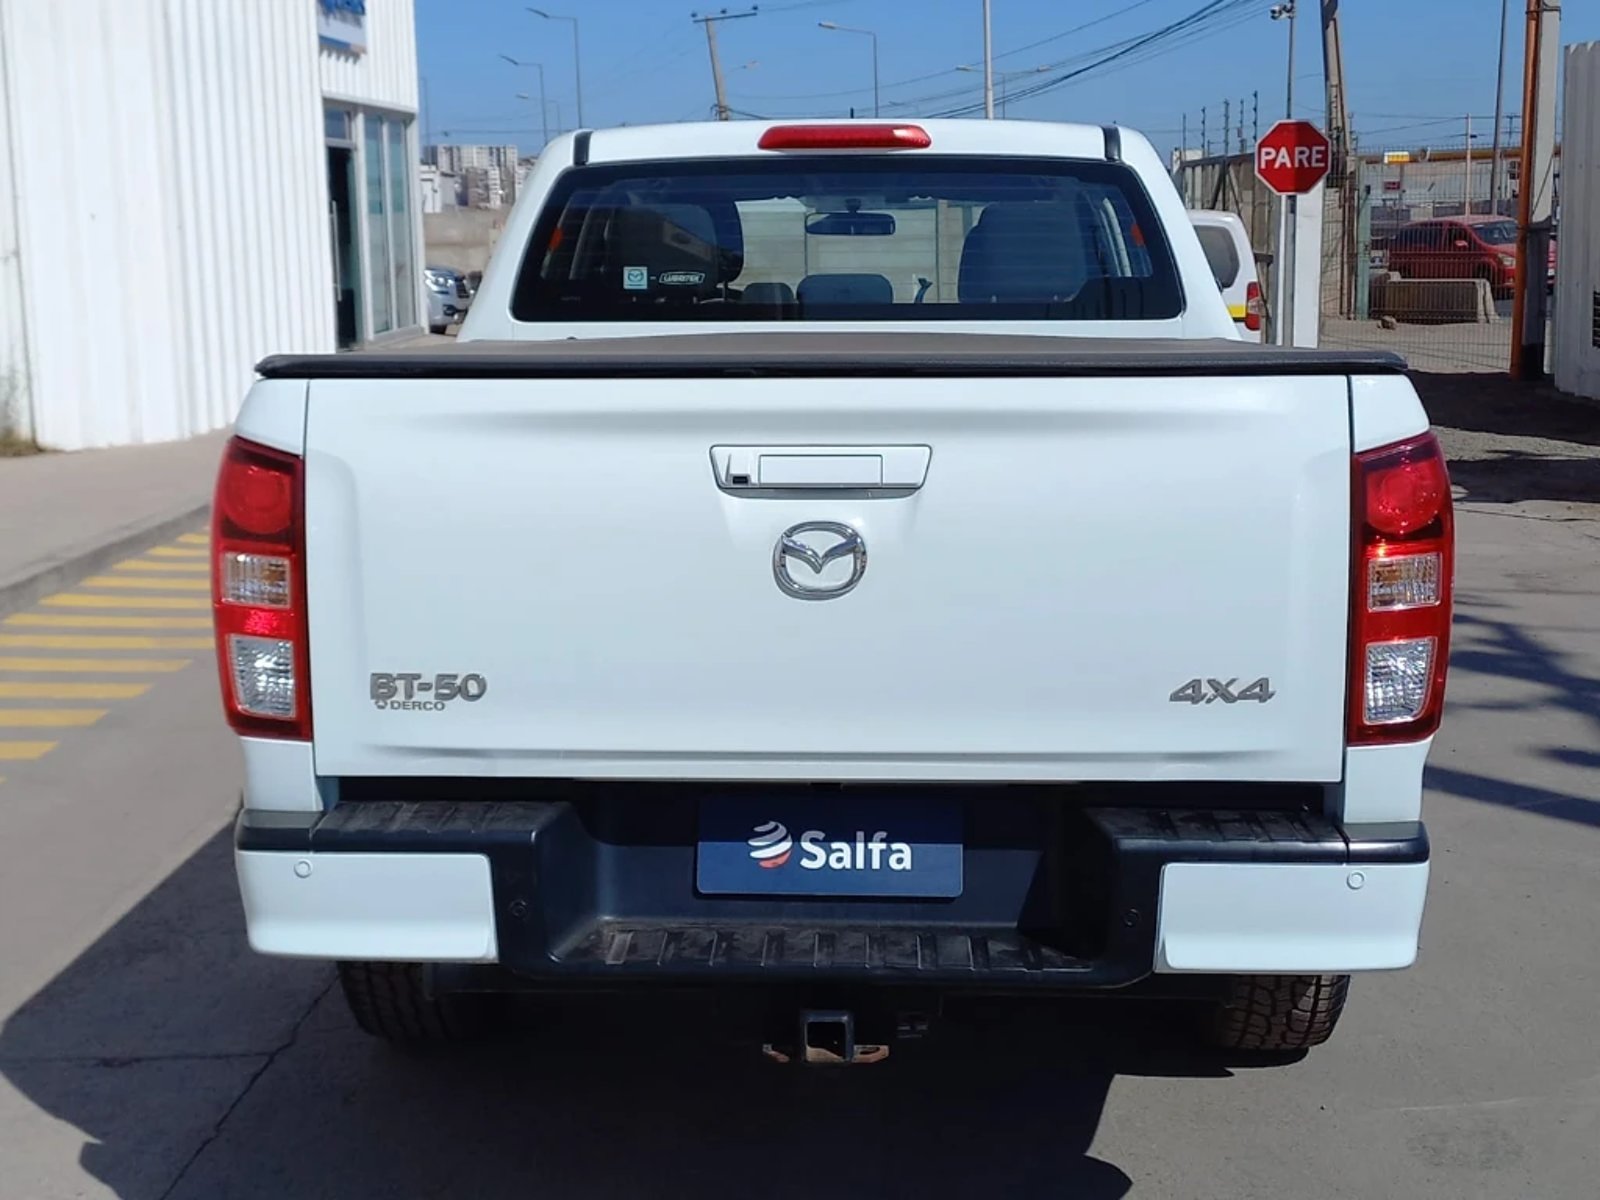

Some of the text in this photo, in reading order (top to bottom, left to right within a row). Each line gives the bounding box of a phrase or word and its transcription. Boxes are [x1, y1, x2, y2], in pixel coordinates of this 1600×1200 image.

[1260, 146, 1326, 169] PARE
[370, 673, 487, 702] BT-50
[1169, 677, 1276, 705] 4X4
[390, 700, 446, 711] DERCO
[800, 830, 912, 870] Salfa
